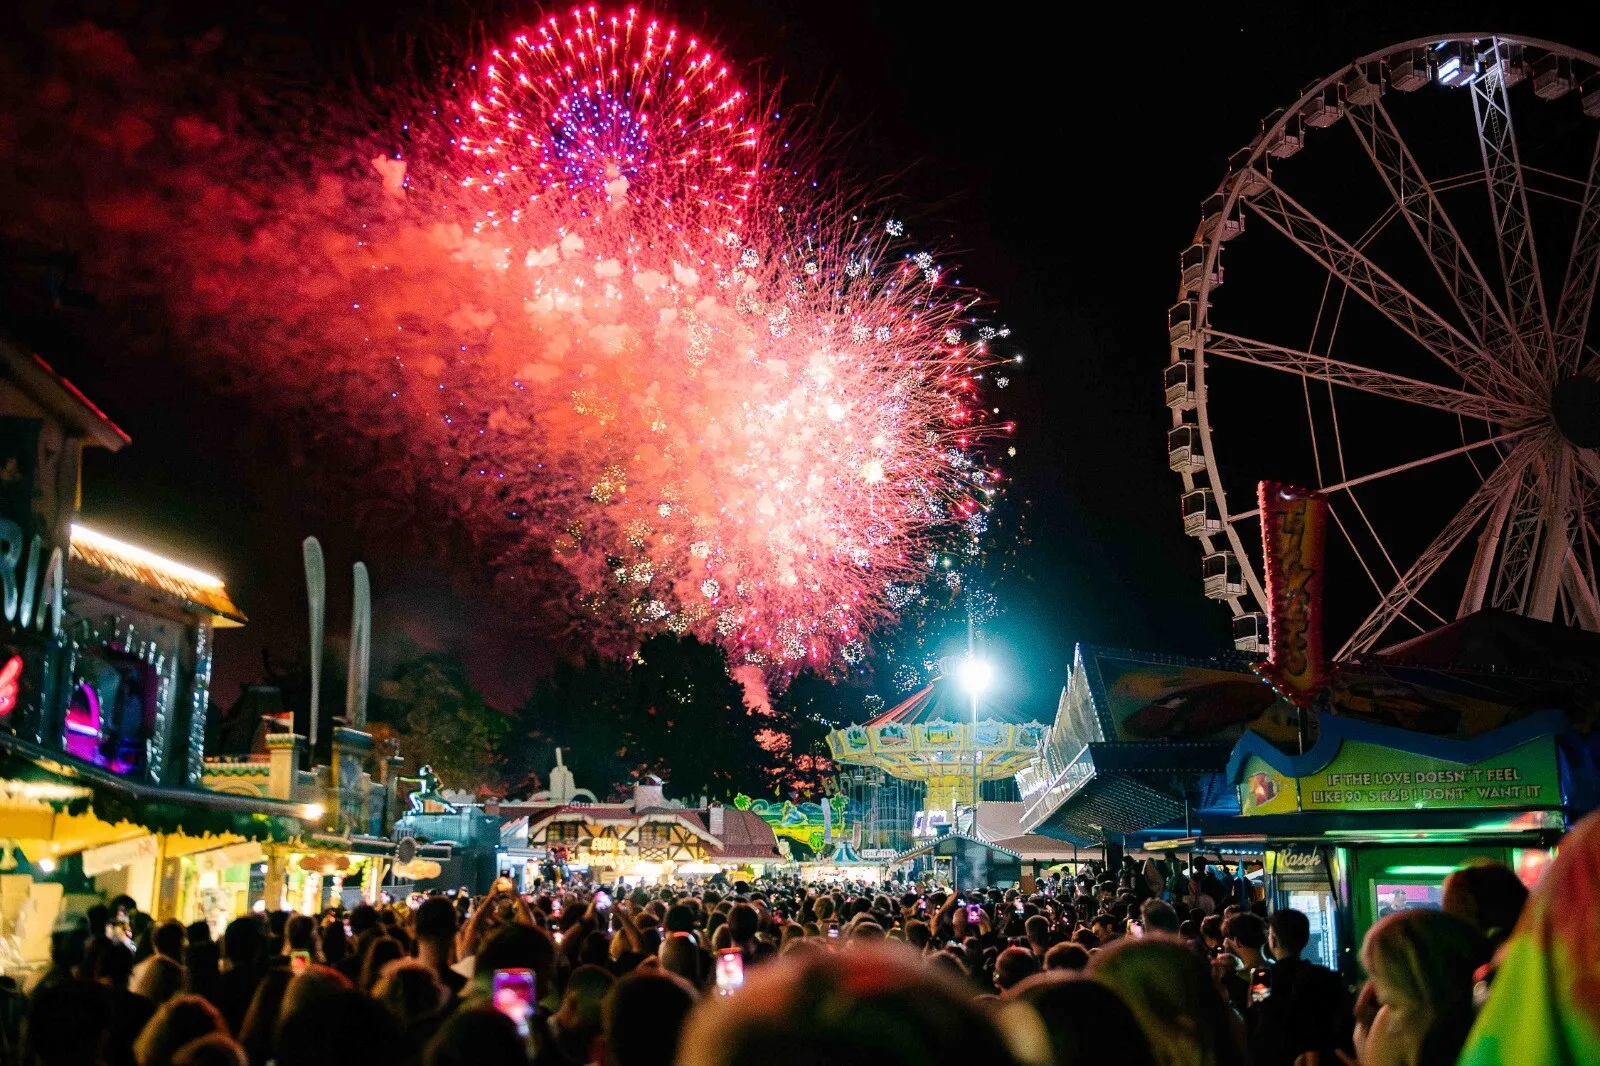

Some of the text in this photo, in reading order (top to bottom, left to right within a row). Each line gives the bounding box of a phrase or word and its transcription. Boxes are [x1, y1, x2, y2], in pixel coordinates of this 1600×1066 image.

[1327, 773, 1340, 786] IF
[1343, 773, 1371, 786] THE
[1375, 772, 1410, 785] LOVE
[1487, 768, 1521, 781] FEEL
[1312, 790, 1341, 803] LIKE
[1476, 785, 1521, 798] WANT
[1526, 785, 1540, 797] IT
